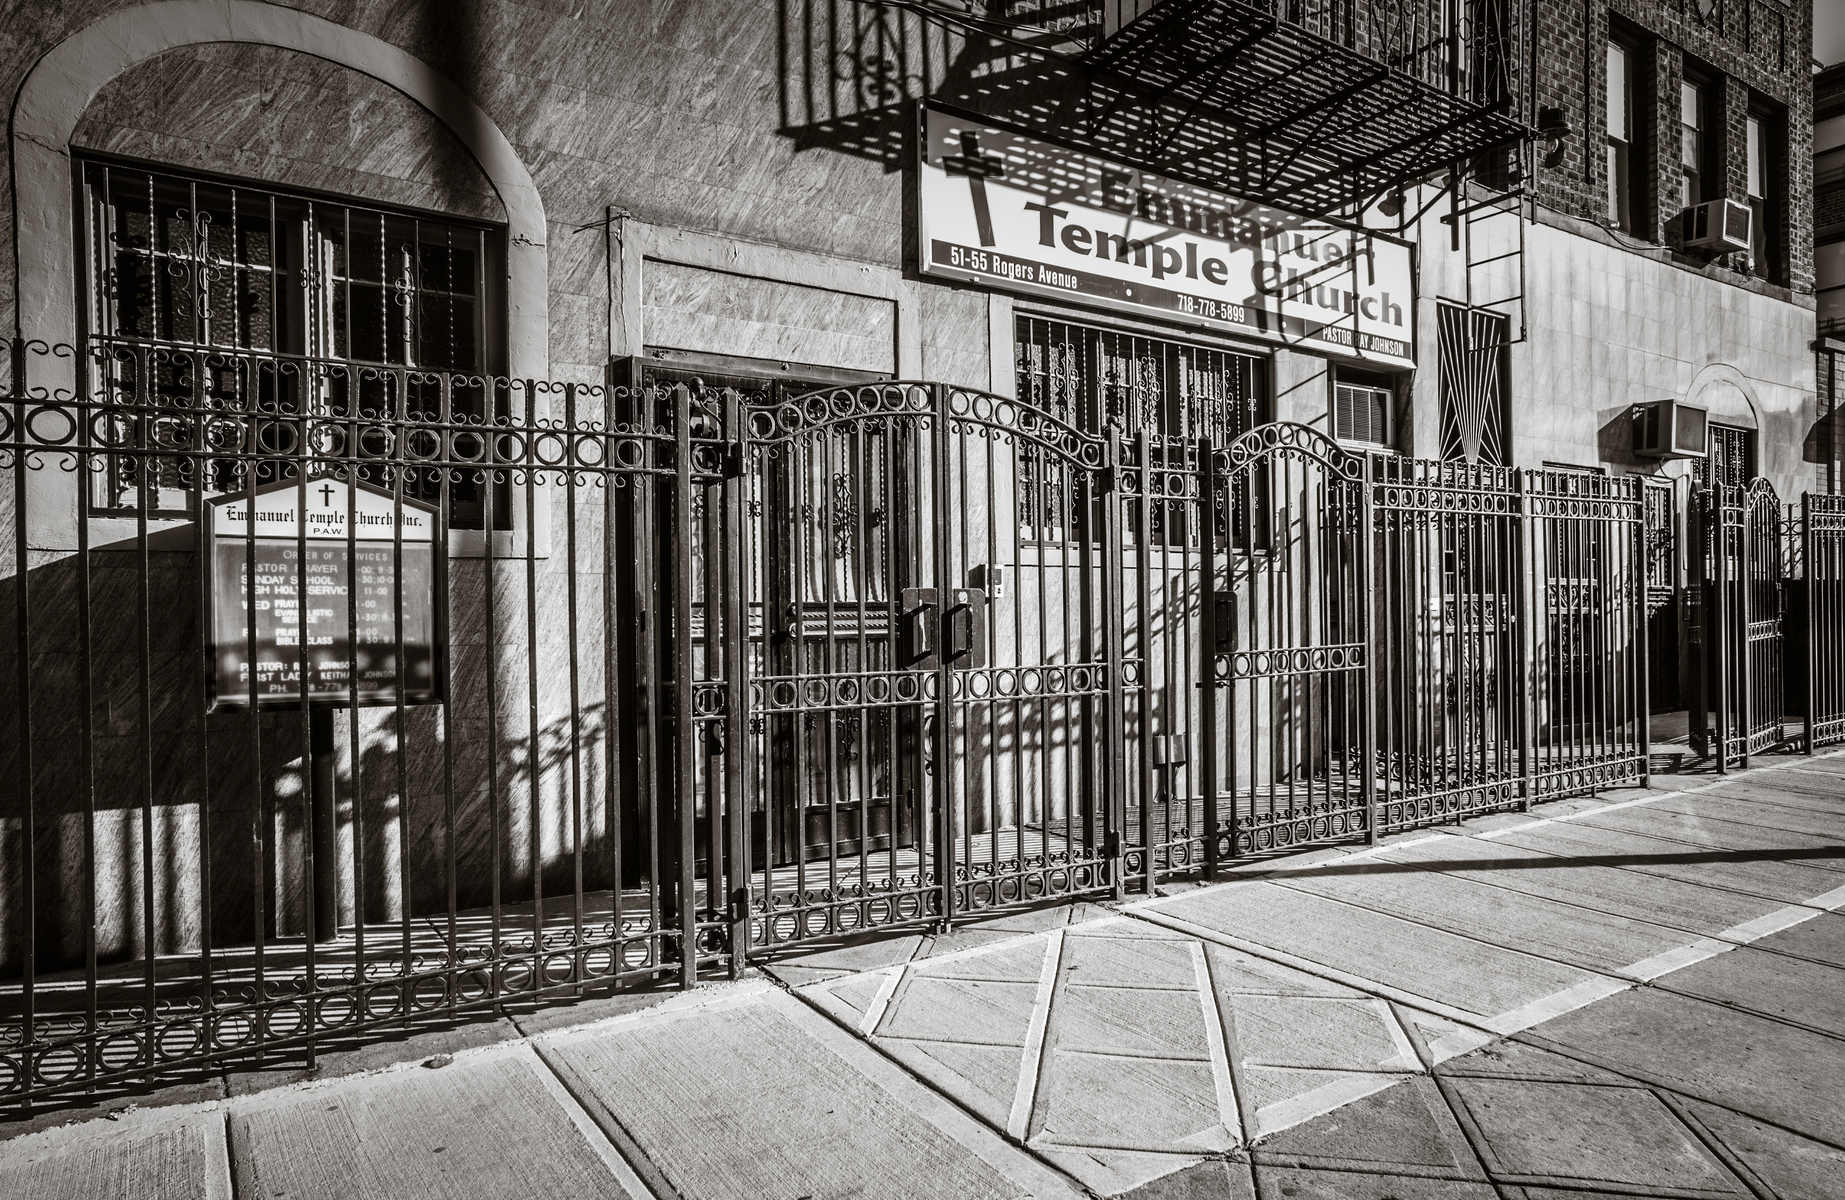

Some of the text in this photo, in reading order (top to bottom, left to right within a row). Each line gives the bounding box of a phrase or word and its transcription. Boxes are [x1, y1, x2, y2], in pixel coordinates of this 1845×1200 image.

[1099, 165, 1356, 270] Emmanuel
[951, 246, 1078, 289] 51-55 Rogers Avenue
[1023, 201, 1403, 328] Temple Church
[1177, 293, 1245, 323] 718-778-5899
[1322, 325, 1352, 346] PASTOR
[1370, 335, 1404, 357] JOHNSON
[313, 527, 344, 536] P.A.W.
[283, 550, 388, 561] ORER OF SRVICES
[241, 563, 287, 573] PSTOR
[241, 575, 285, 585] SNDAY
[290, 576, 335, 586] SHOOL
[241, 585, 270, 595] HGH
[275, 637, 301, 645] BIBLE
[306, 637, 333, 645] CLASS
[240, 662, 288, 672] PSTOR:
